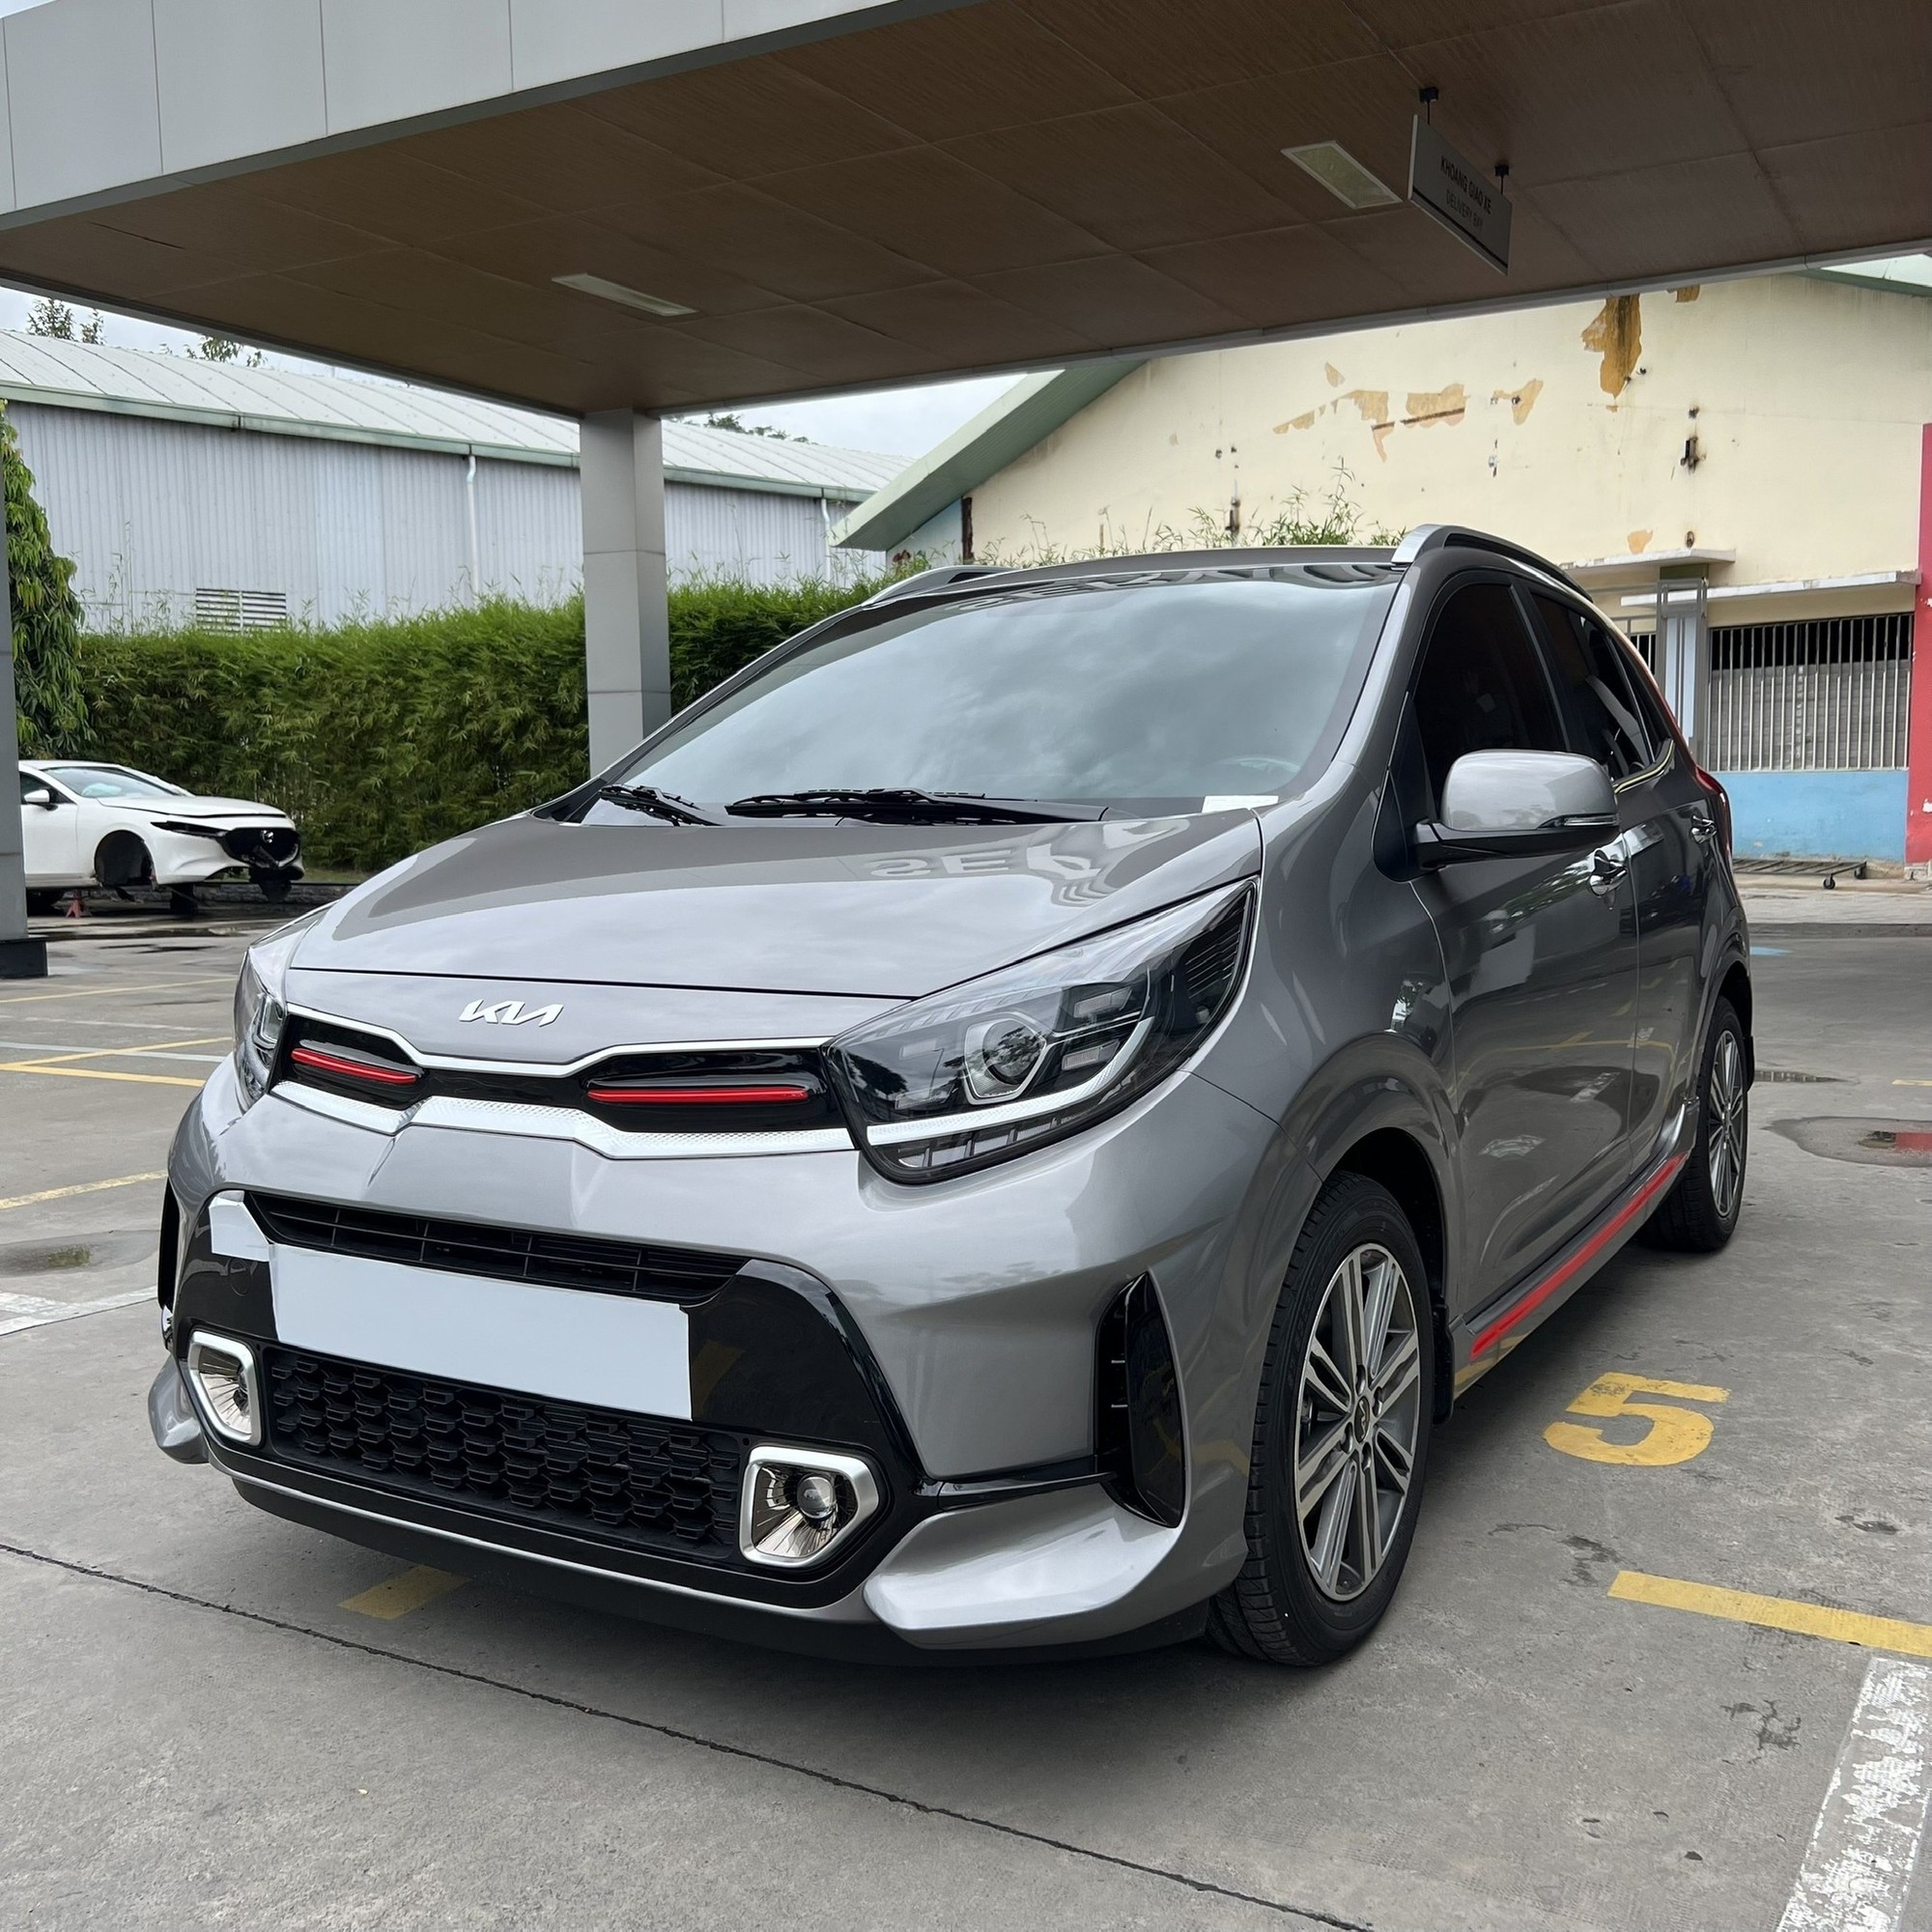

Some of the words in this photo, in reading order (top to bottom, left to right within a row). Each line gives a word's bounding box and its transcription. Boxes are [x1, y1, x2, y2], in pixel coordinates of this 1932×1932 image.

[1440, 155, 1468, 193] KHOANG
[1446, 188, 1472, 222] DELIVERY
[459, 998, 564, 1027] KIA
[1543, 1372, 1732, 1466] 5
